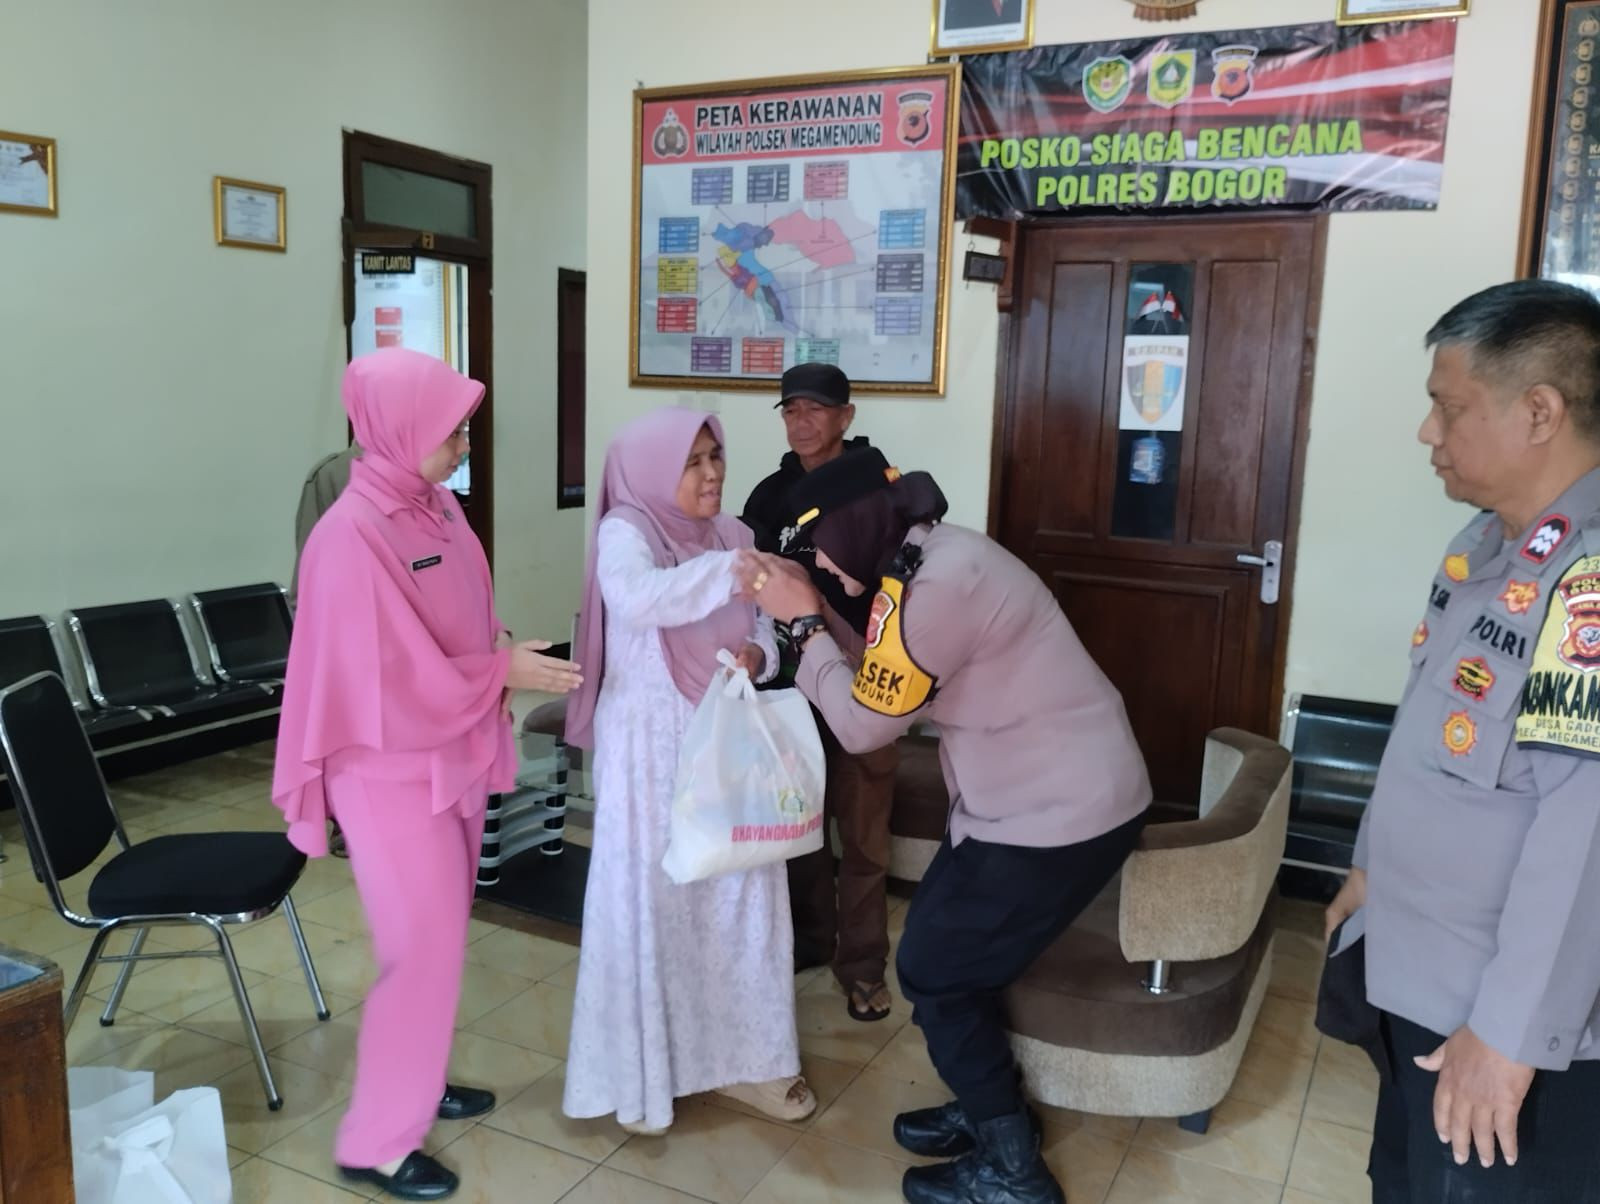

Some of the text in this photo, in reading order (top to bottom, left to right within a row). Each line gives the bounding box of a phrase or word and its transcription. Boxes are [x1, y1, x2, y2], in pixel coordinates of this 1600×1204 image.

[697, 94, 882, 128] PETA KERAWANAN
[696, 122, 881, 154] WILAYAH POLSEK MEGAMENDUNG
[981, 119, 1363, 169] POSKO SIAGA BENCANA
[1037, 167, 1287, 206] POLRES BOGOR
[363, 255, 412, 271] KANIT LANTAS
[1470, 615, 1526, 659] POLRI
